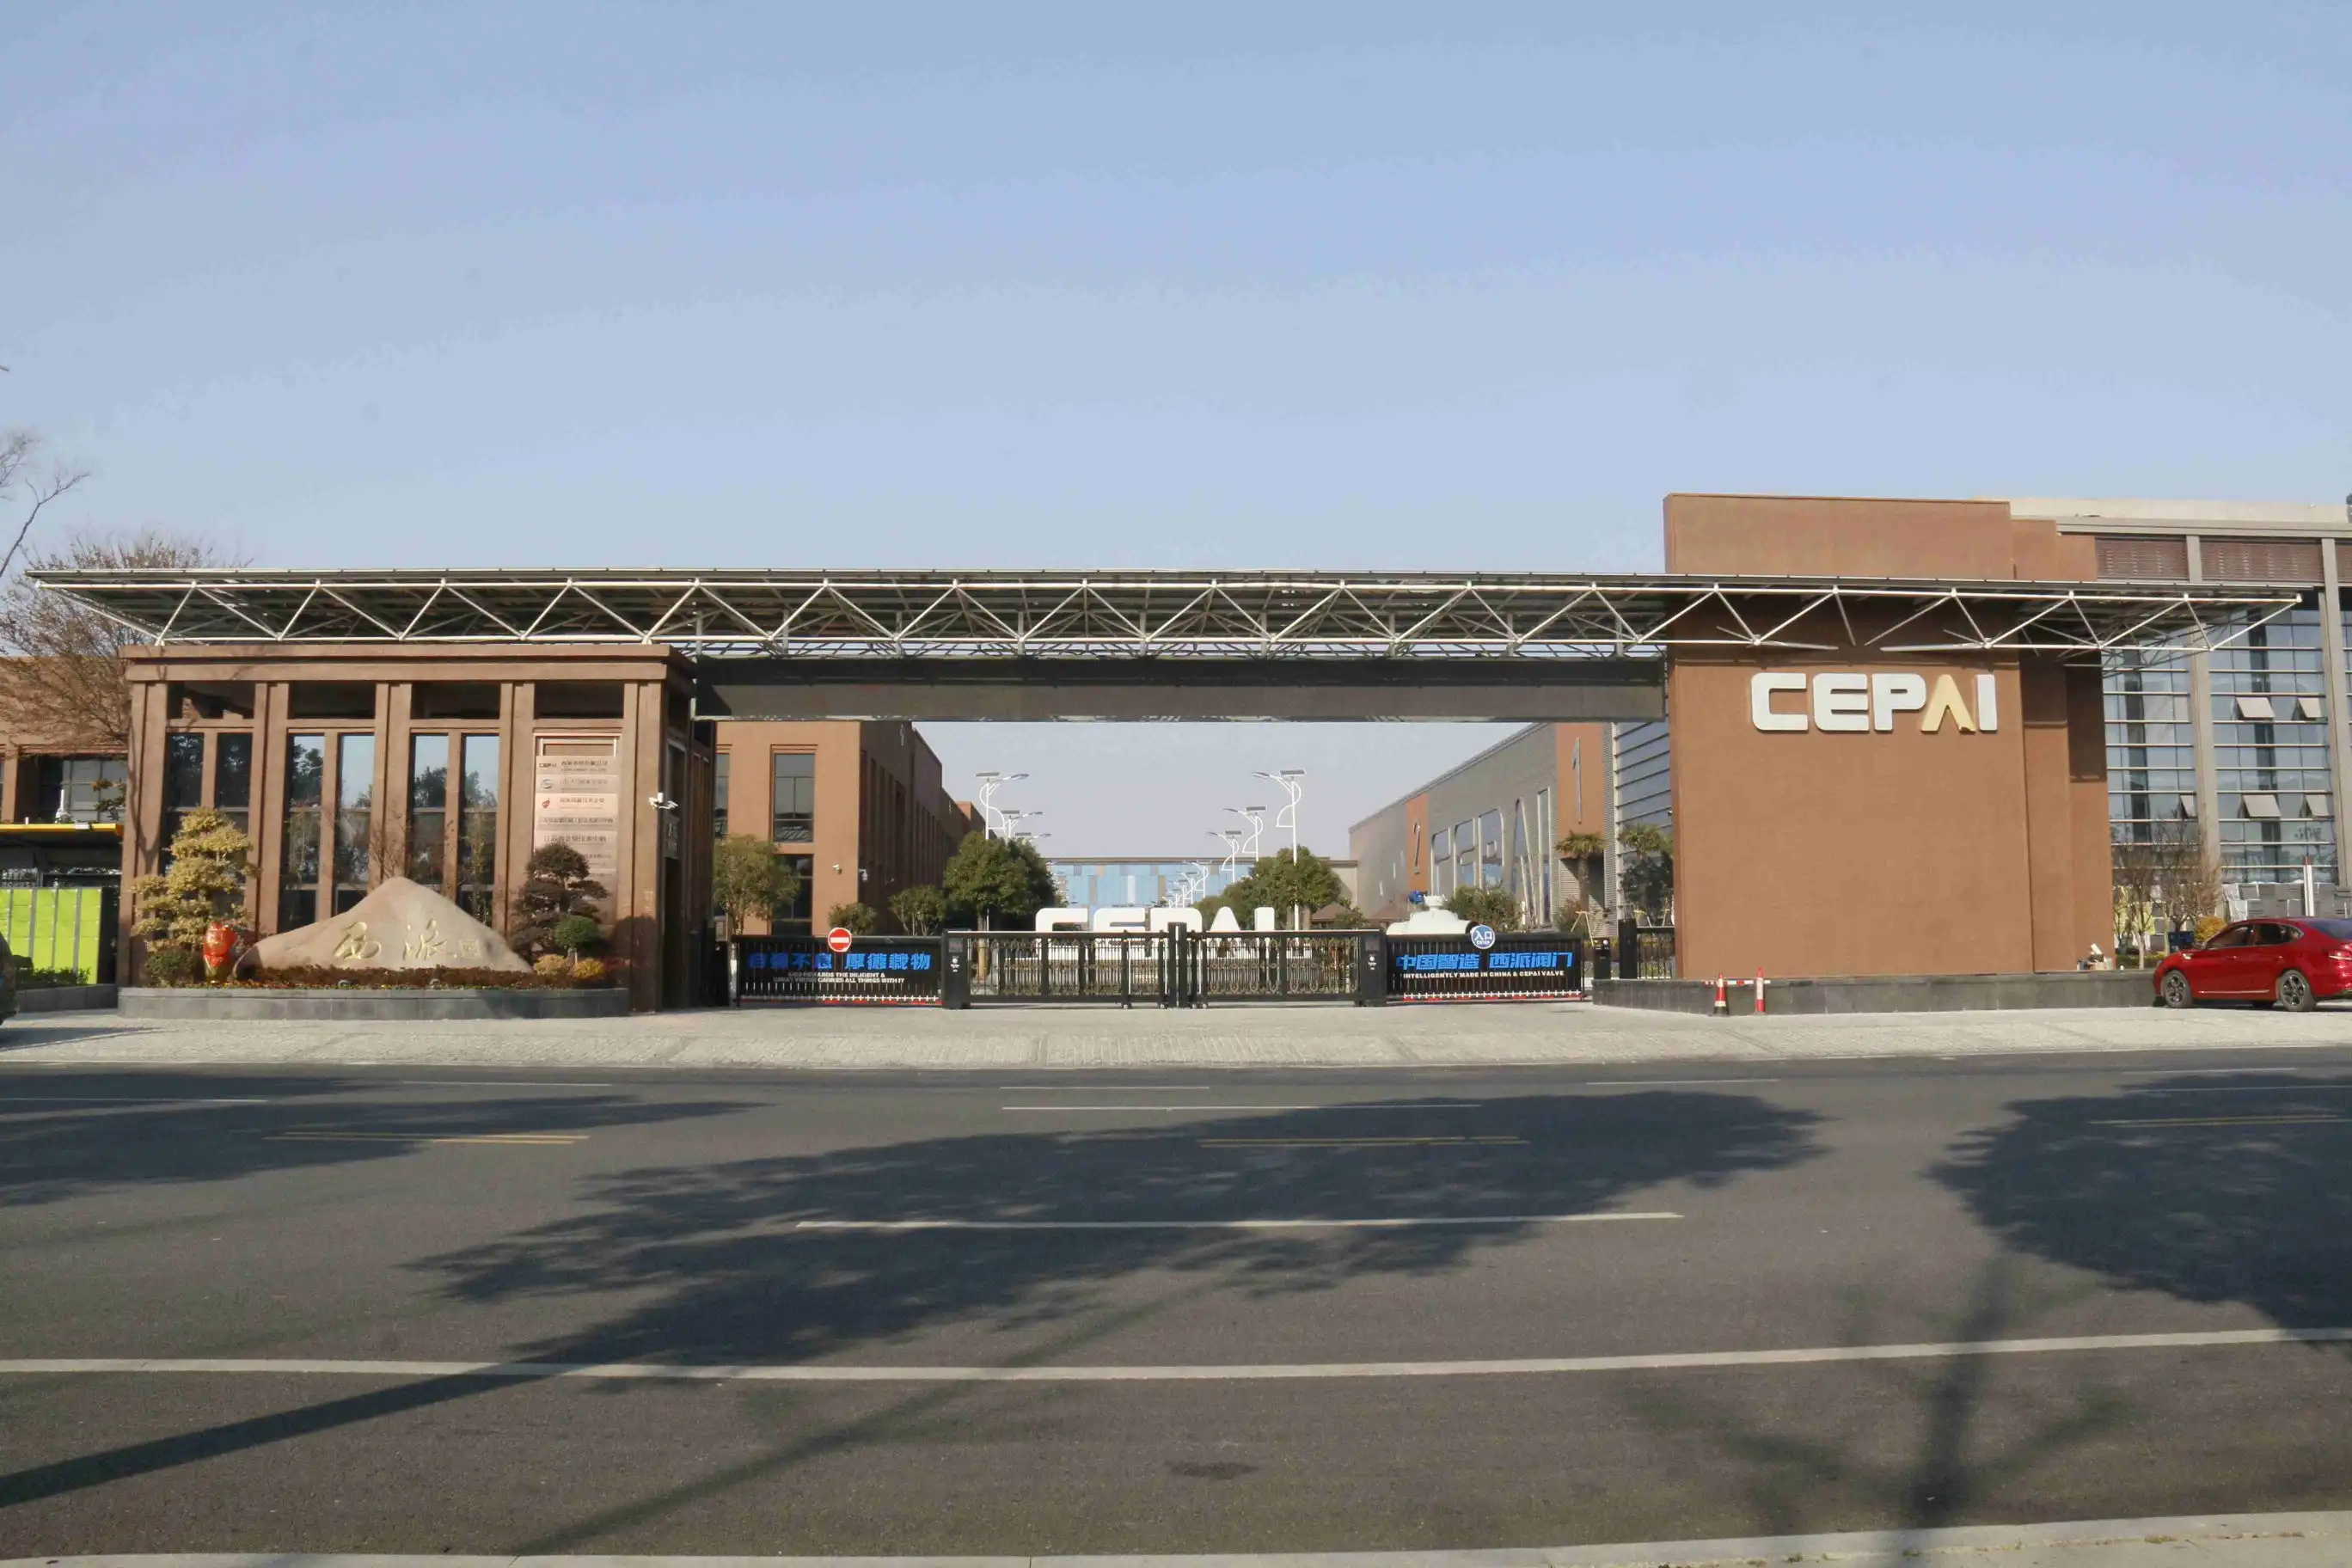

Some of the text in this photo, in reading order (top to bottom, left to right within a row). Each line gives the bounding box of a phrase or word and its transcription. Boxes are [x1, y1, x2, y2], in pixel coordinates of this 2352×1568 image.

[1751, 672, 1998, 732] CEPAI
[1474, 930, 1492, 941] 入口
[1400, 952, 1573, 971] 中国智造 西派阀门
